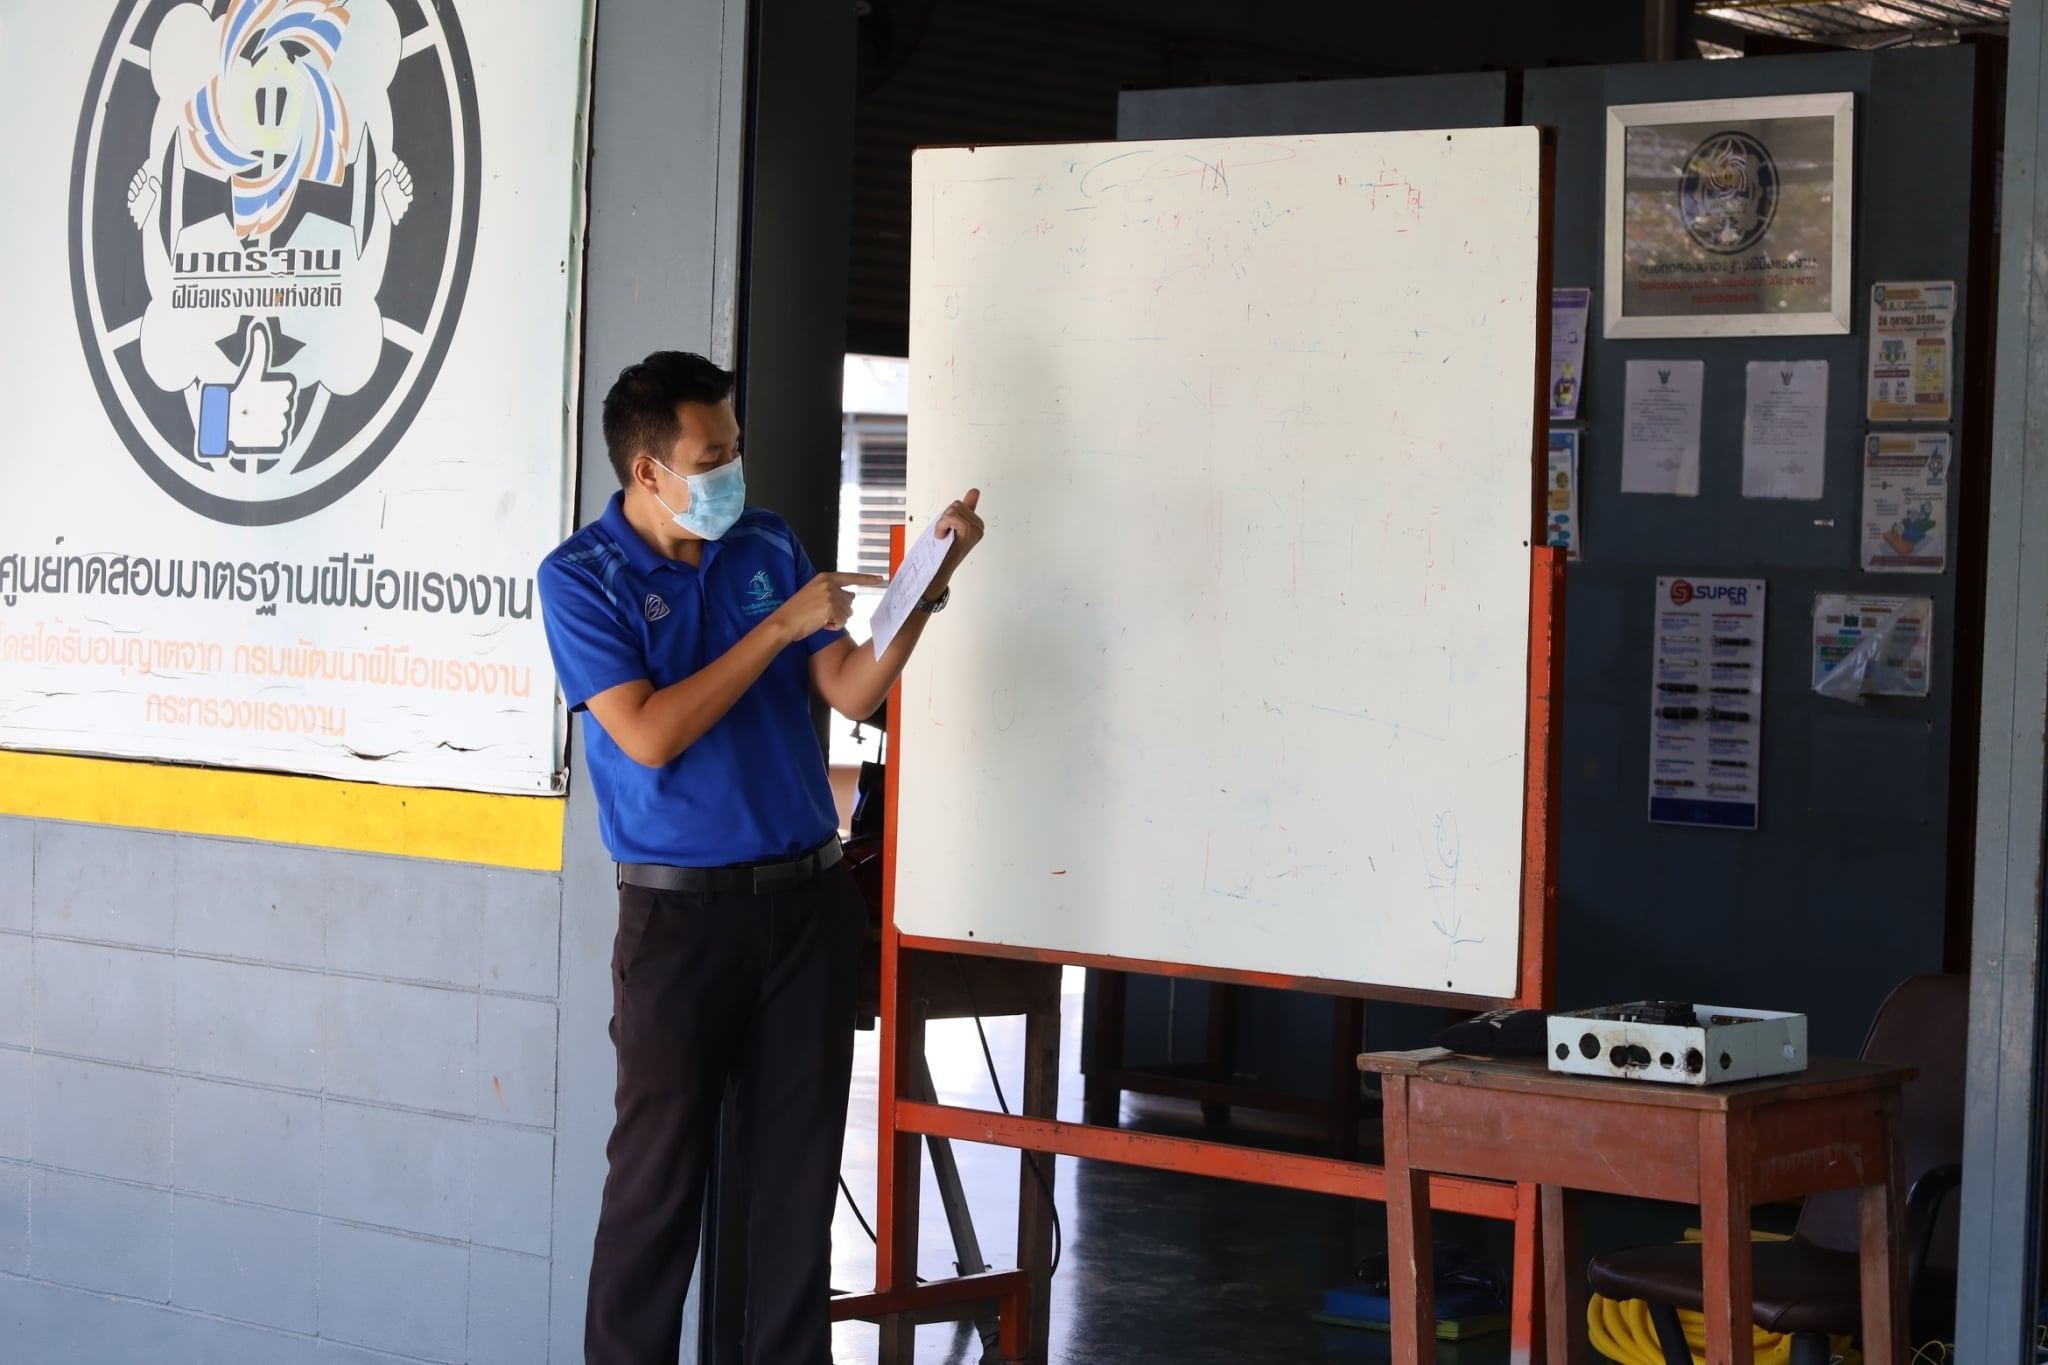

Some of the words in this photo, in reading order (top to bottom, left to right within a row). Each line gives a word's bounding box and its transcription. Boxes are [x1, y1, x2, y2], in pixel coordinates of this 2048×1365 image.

[175, 249, 342, 276] มาตรฐาน
[172, 283, 342, 309] ฝีมือแรงงานแห่งชาติ
[0, 536, 533, 620] ศูนย์ทดสอบมาตรฐานฝีมือแรงงาน
[1693, 586, 1747, 601] SUPER
[233, 638, 532, 698] กรมพัฒนาฝีมือแรงงาน
[146, 693, 346, 736] กระทรวงแรงงาน
